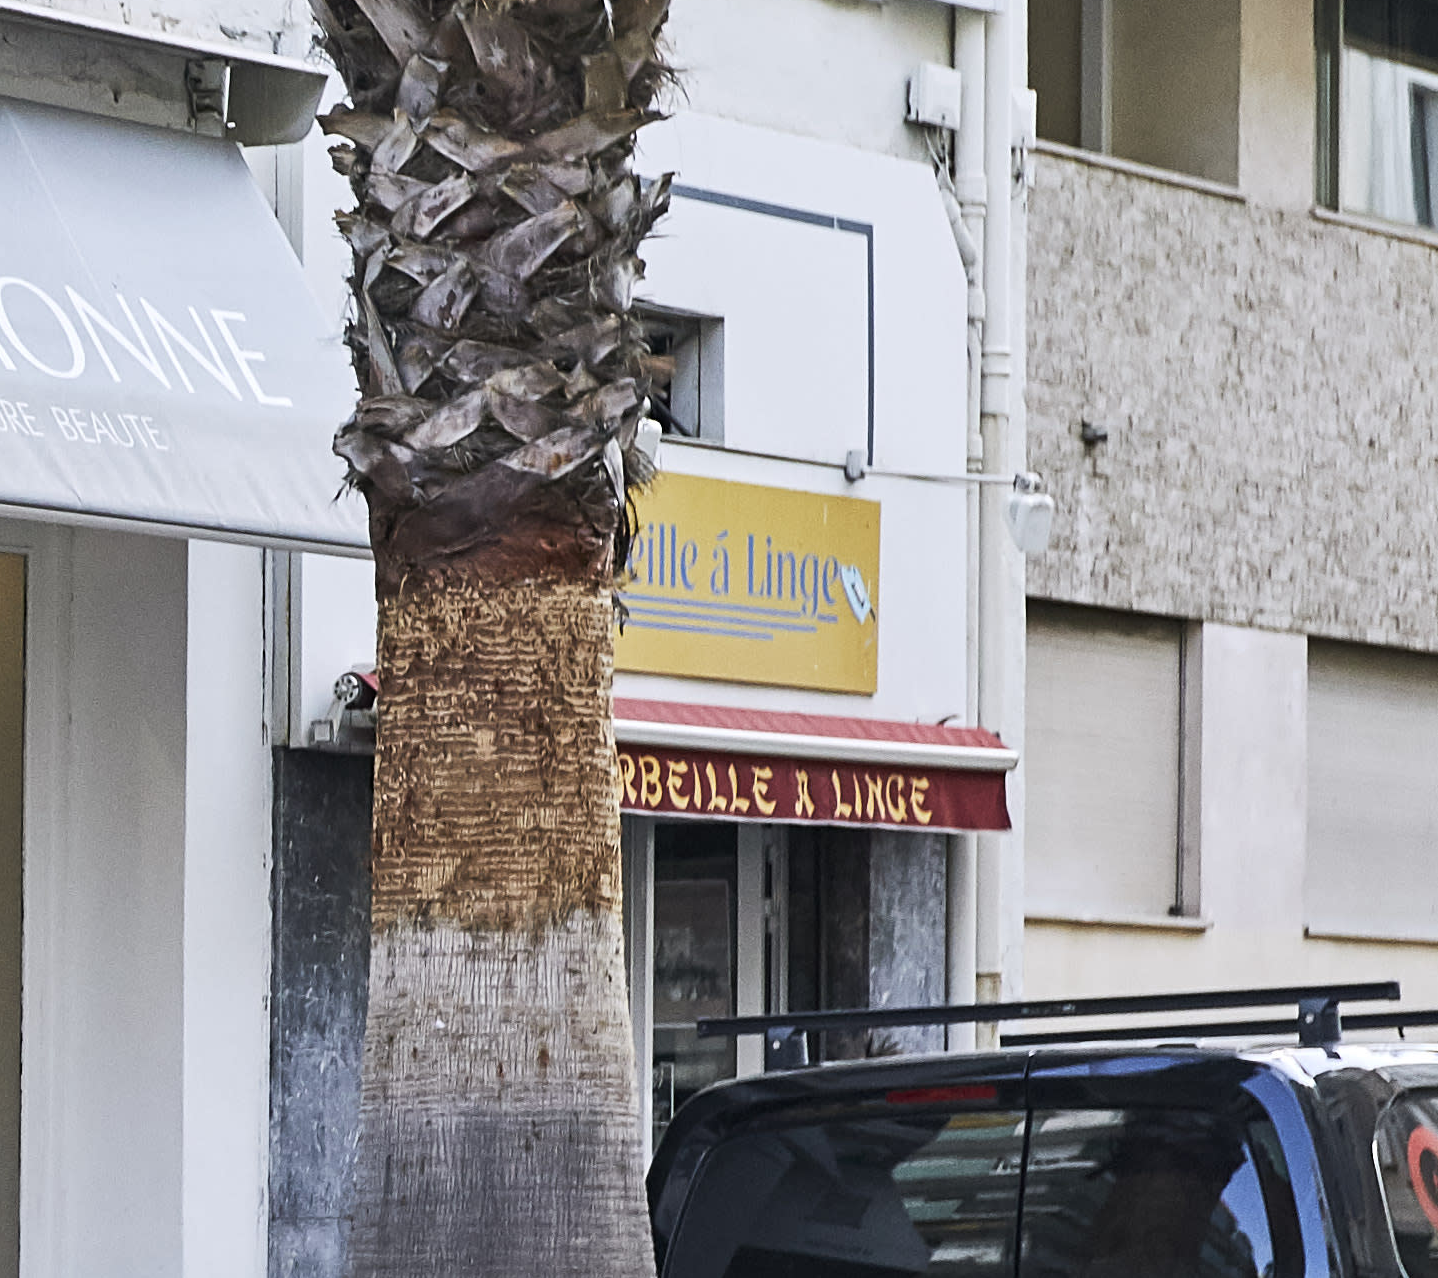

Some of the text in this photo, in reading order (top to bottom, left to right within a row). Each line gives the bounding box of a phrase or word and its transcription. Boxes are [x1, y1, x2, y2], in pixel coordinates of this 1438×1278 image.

[51, 408, 169, 451] BEAUTE
[747, 533, 840, 617] Linge
[832, 769, 932, 825] LINGE
